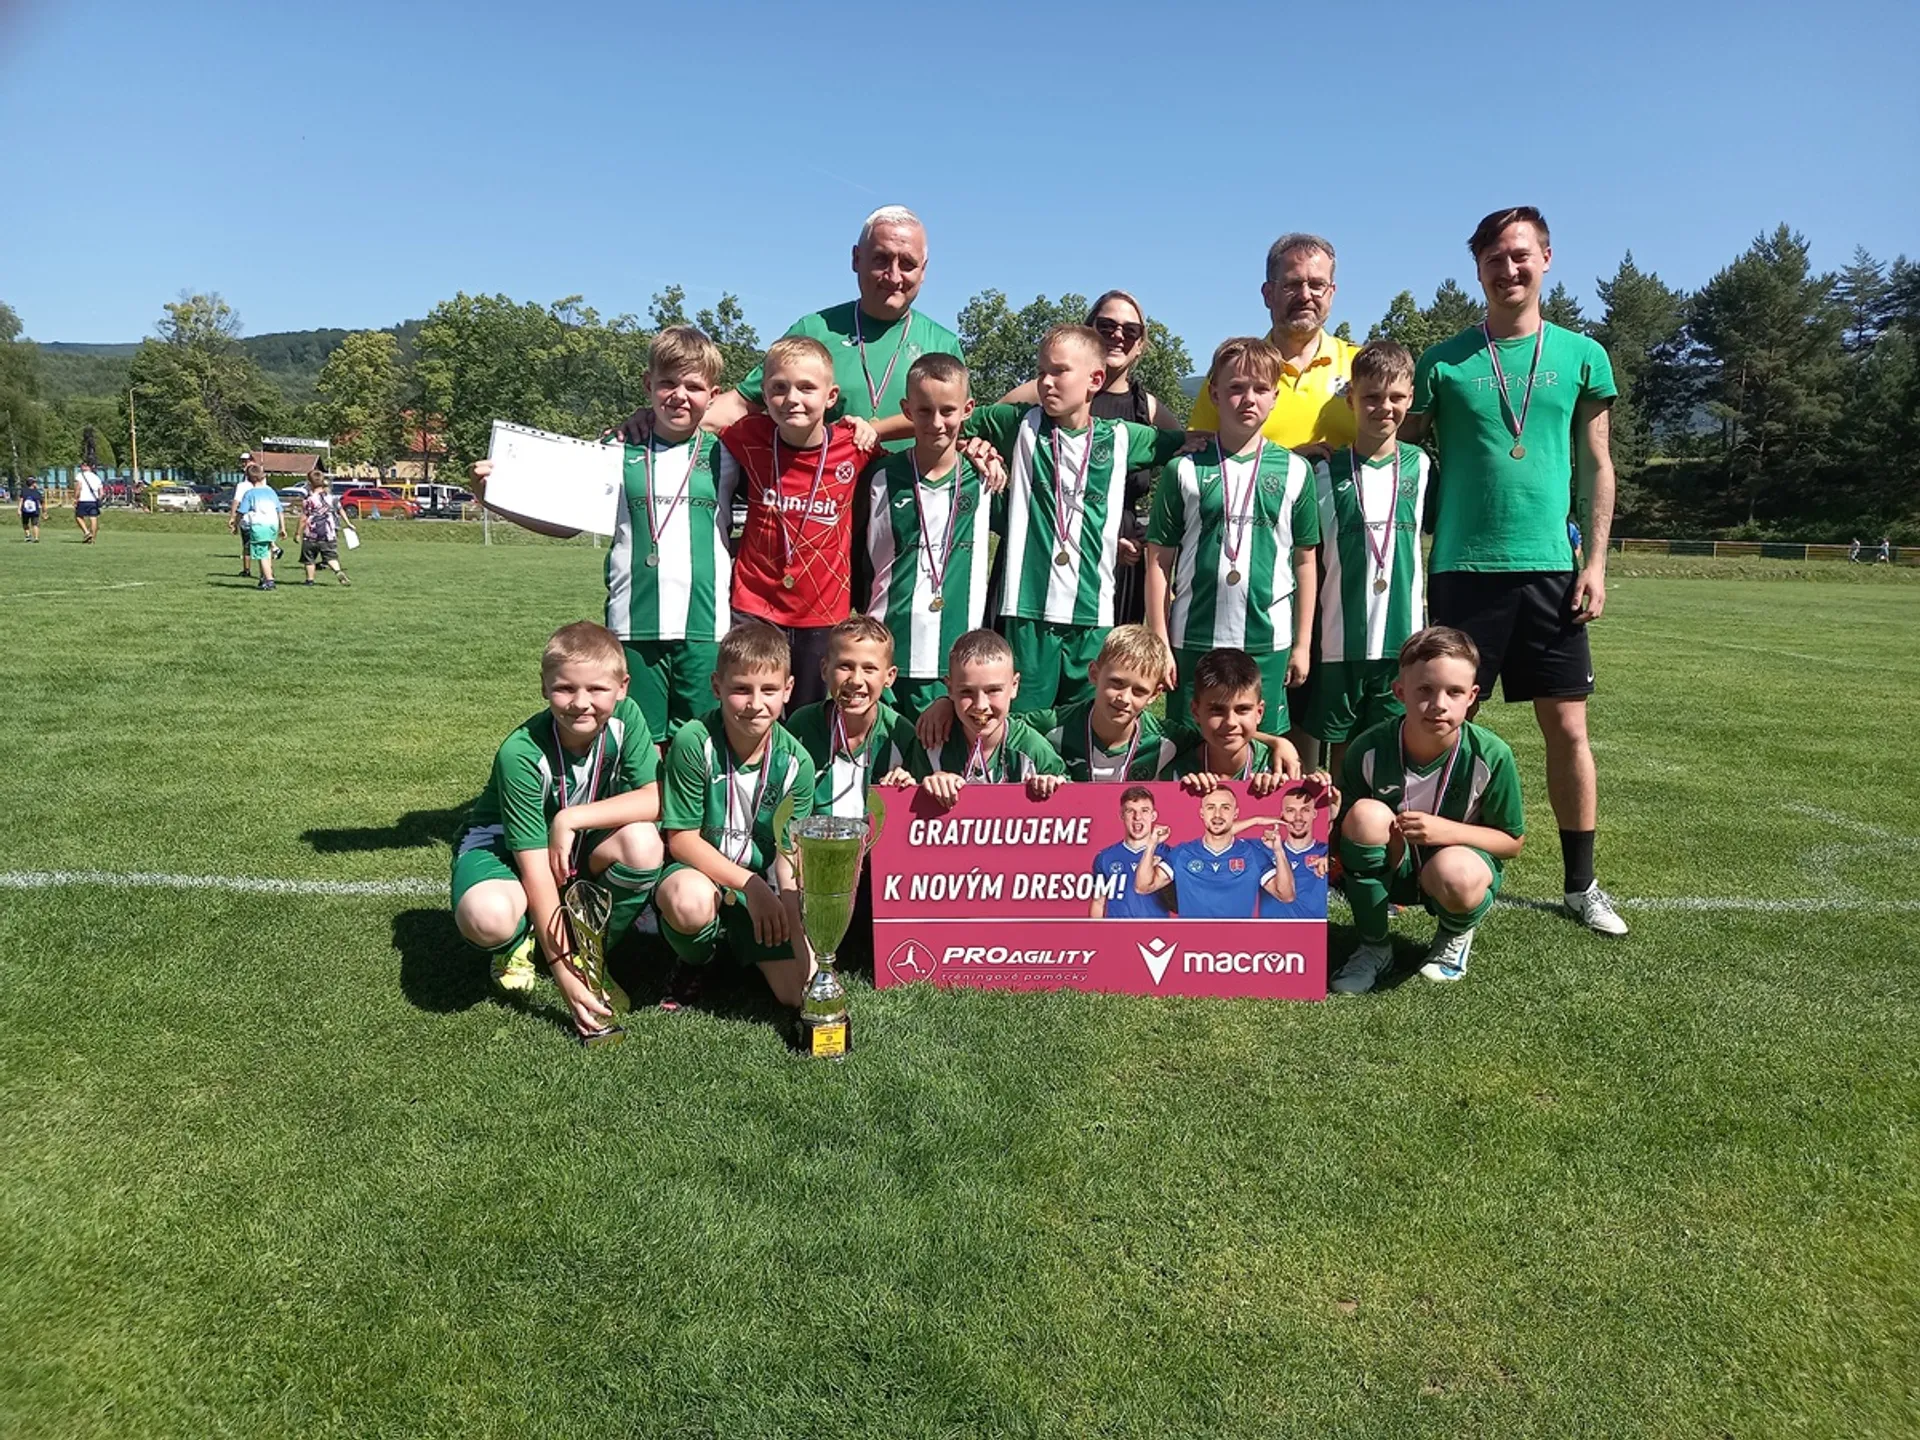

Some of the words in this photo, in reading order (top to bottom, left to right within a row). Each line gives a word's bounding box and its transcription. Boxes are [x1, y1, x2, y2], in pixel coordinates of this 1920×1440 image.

[909, 817, 1092, 846] GRATULUJEME
[883, 874, 904, 901] K
[909, 867, 1005, 901] NOVÝM
[1011, 872, 1128, 900] DRESOM!
[1182, 951, 1306, 975] macron
